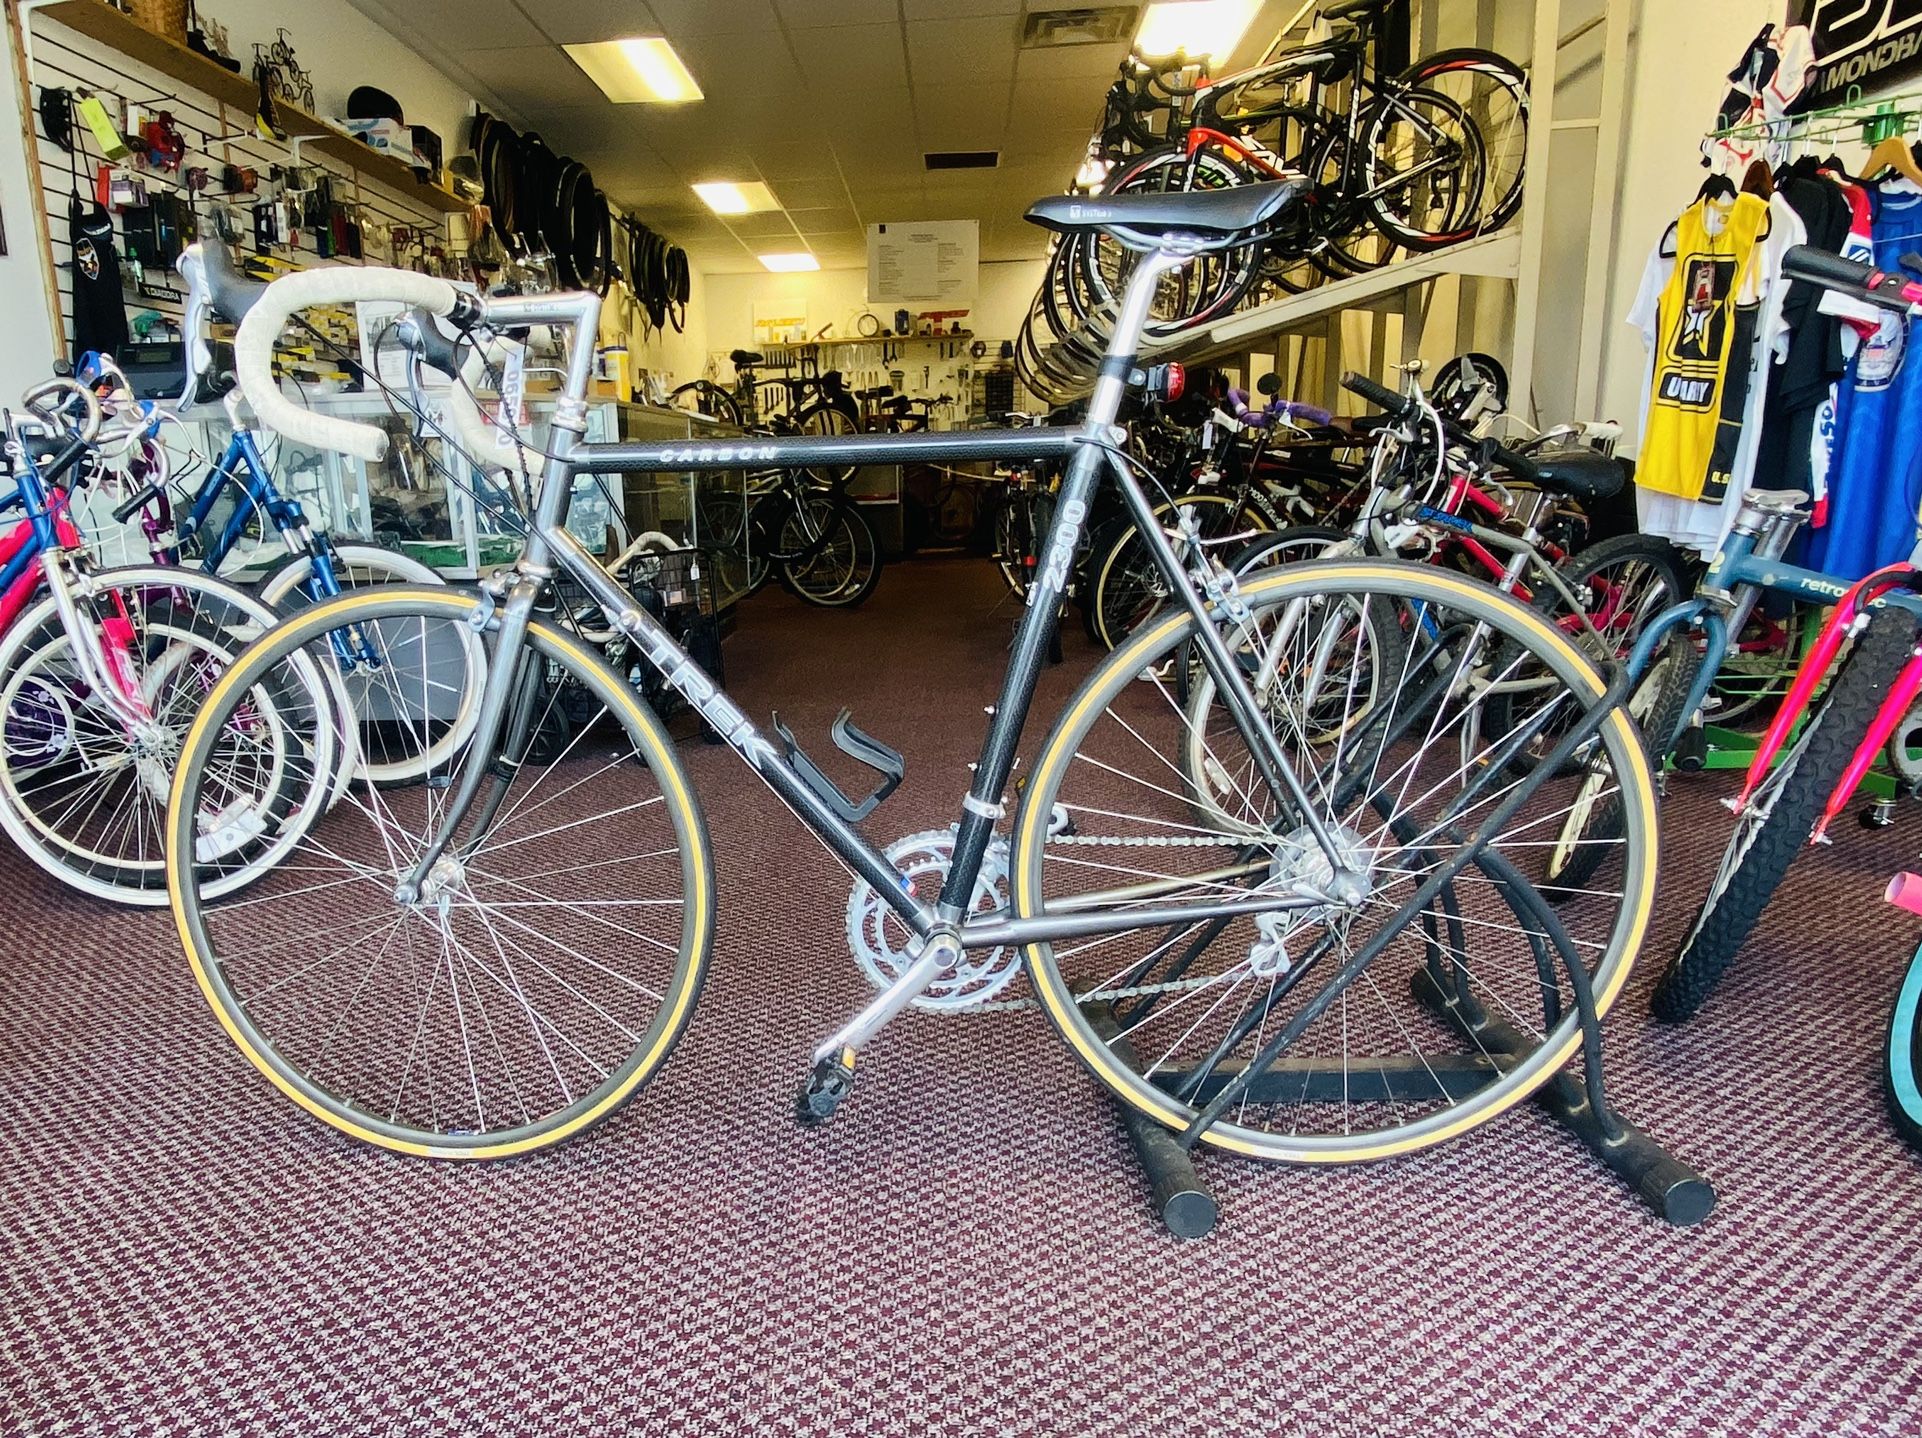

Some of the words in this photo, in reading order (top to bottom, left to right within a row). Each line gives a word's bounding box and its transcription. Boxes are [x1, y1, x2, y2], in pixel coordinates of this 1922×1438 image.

[660, 446, 777, 462] CARBON
[1043, 500, 1085, 593] 2300
[651, 629, 778, 770] TREK
